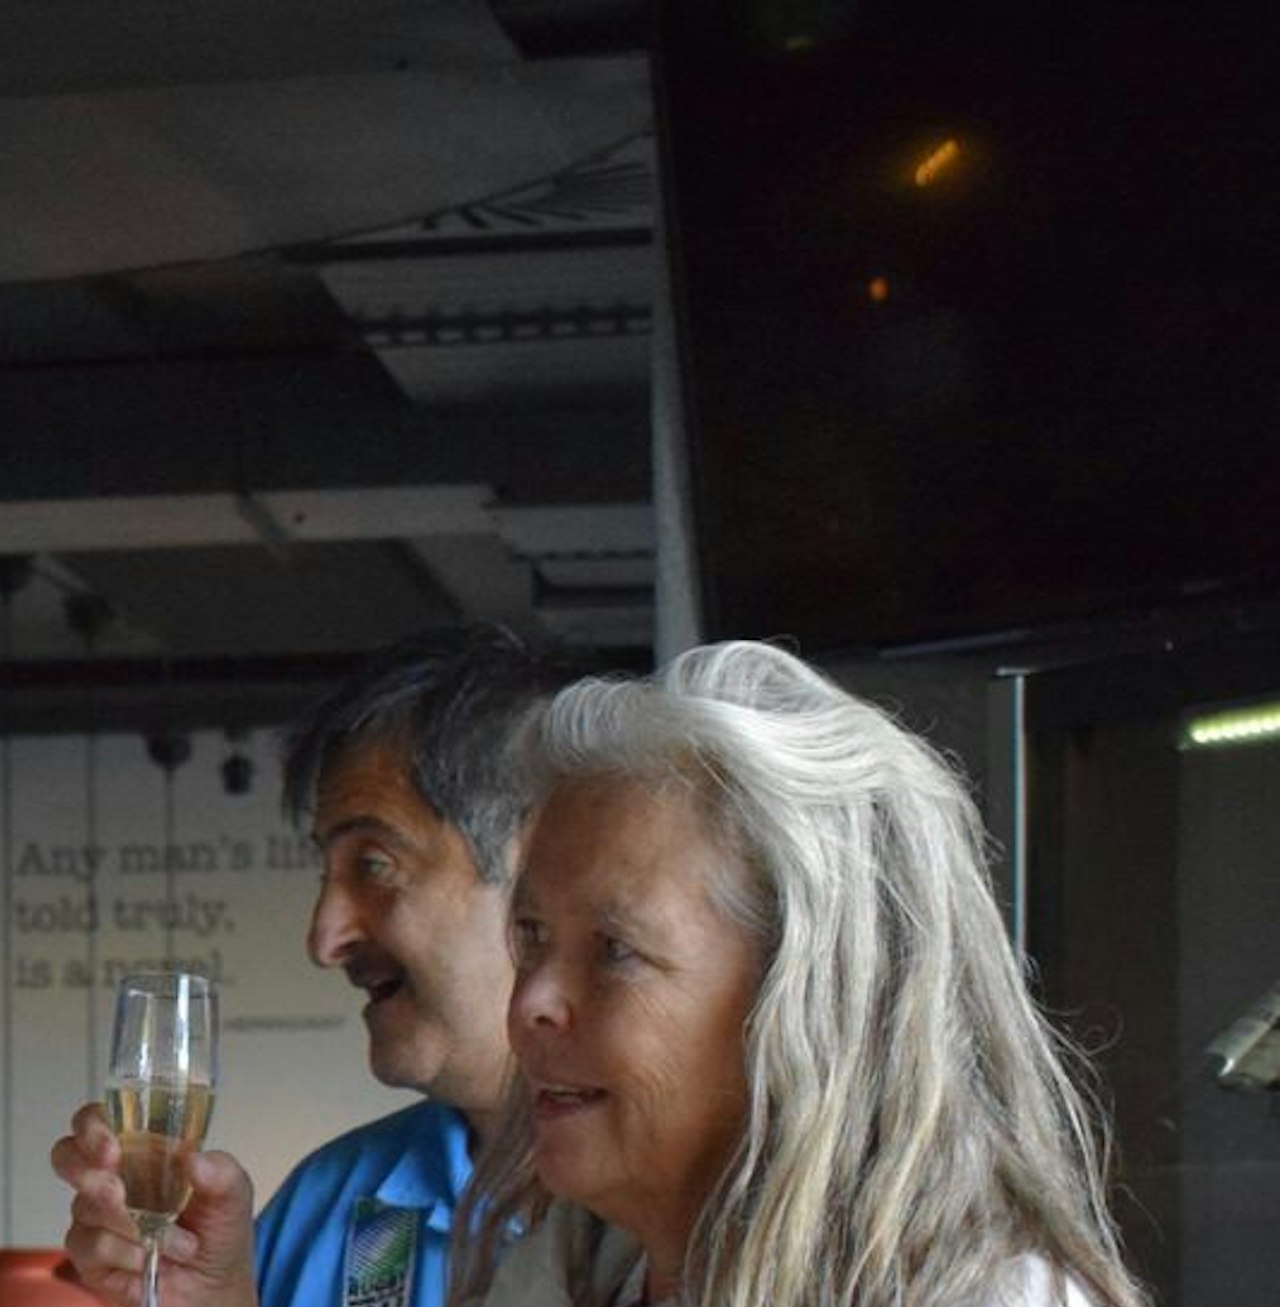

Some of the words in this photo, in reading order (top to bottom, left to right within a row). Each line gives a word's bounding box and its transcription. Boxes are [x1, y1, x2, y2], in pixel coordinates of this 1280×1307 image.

[16, 841, 106, 881] Any
[119, 836, 253, 873] man's
[15, 895, 100, 932] told
[16, 956, 52, 987] is
[62, 959, 95, 986] a
